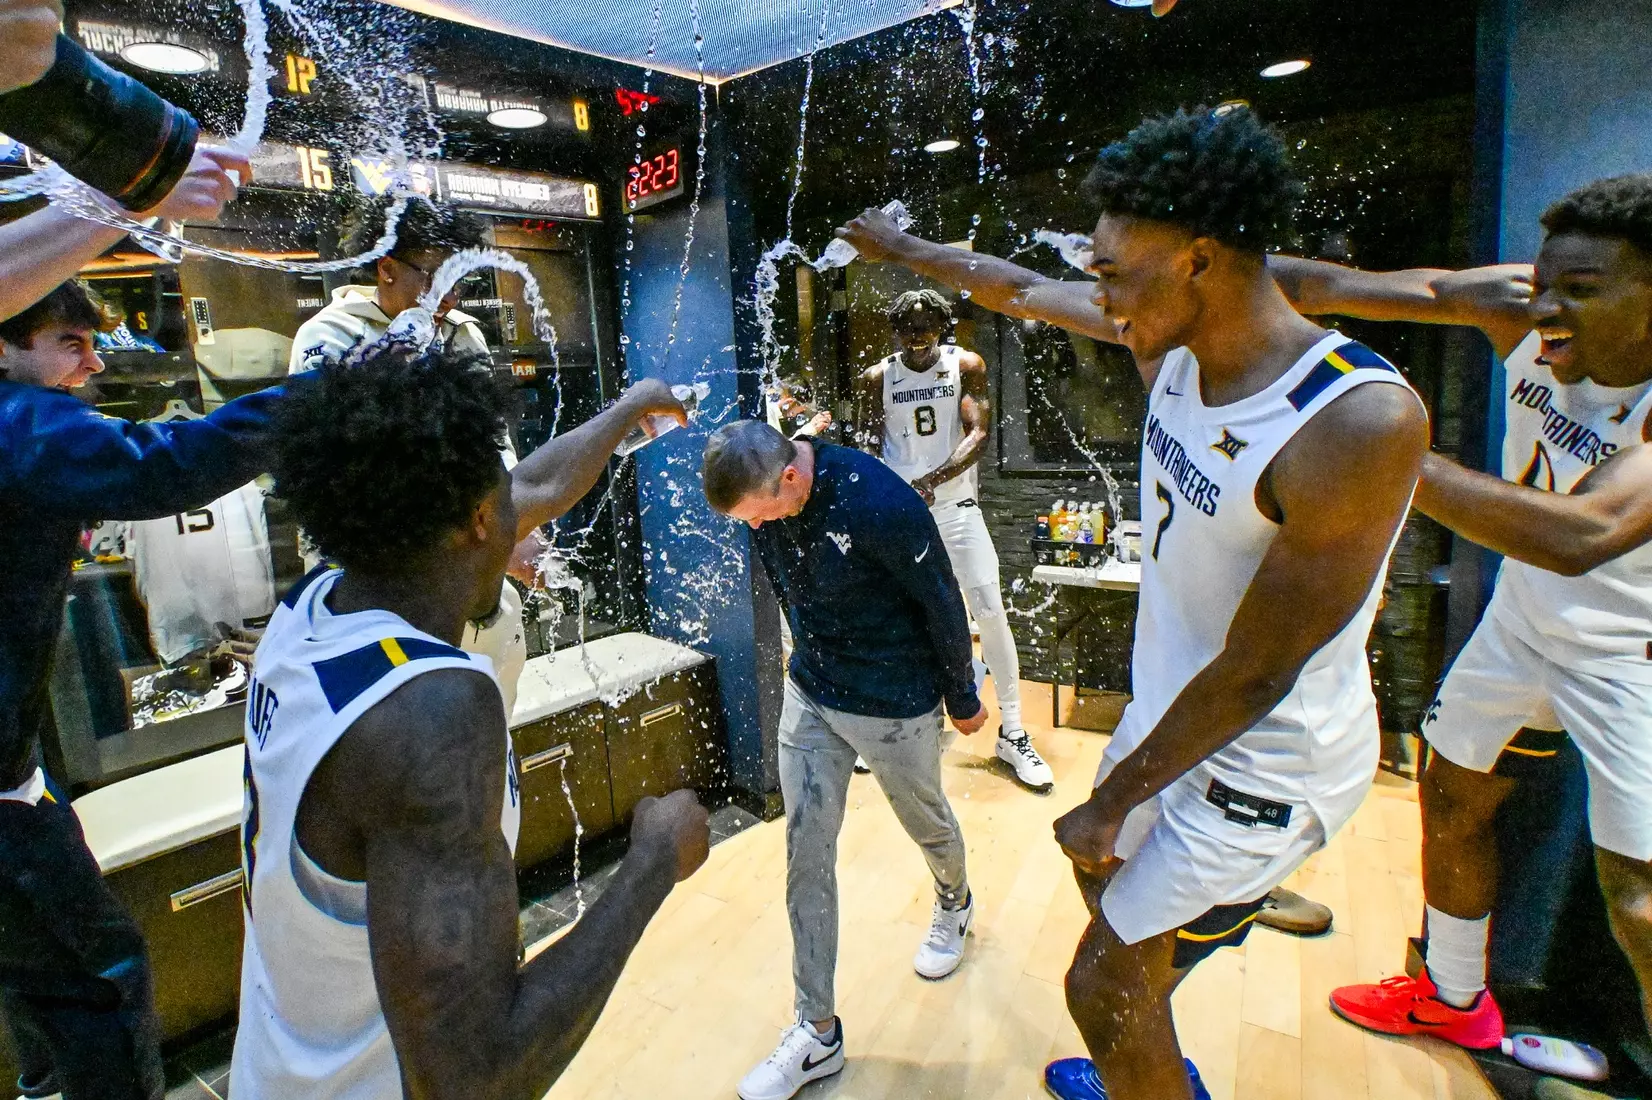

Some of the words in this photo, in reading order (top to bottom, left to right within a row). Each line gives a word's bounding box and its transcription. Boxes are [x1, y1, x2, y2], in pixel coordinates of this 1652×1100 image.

[296, 146, 333, 191] 15
[626, 148, 678, 200] 22:23
[583, 183, 599, 217] 8
[892, 385, 955, 404] MOUNTAINEERS
[914, 405, 937, 436] 8
[1152, 479, 1175, 563] 7
[1264, 807, 1279, 819] 48
